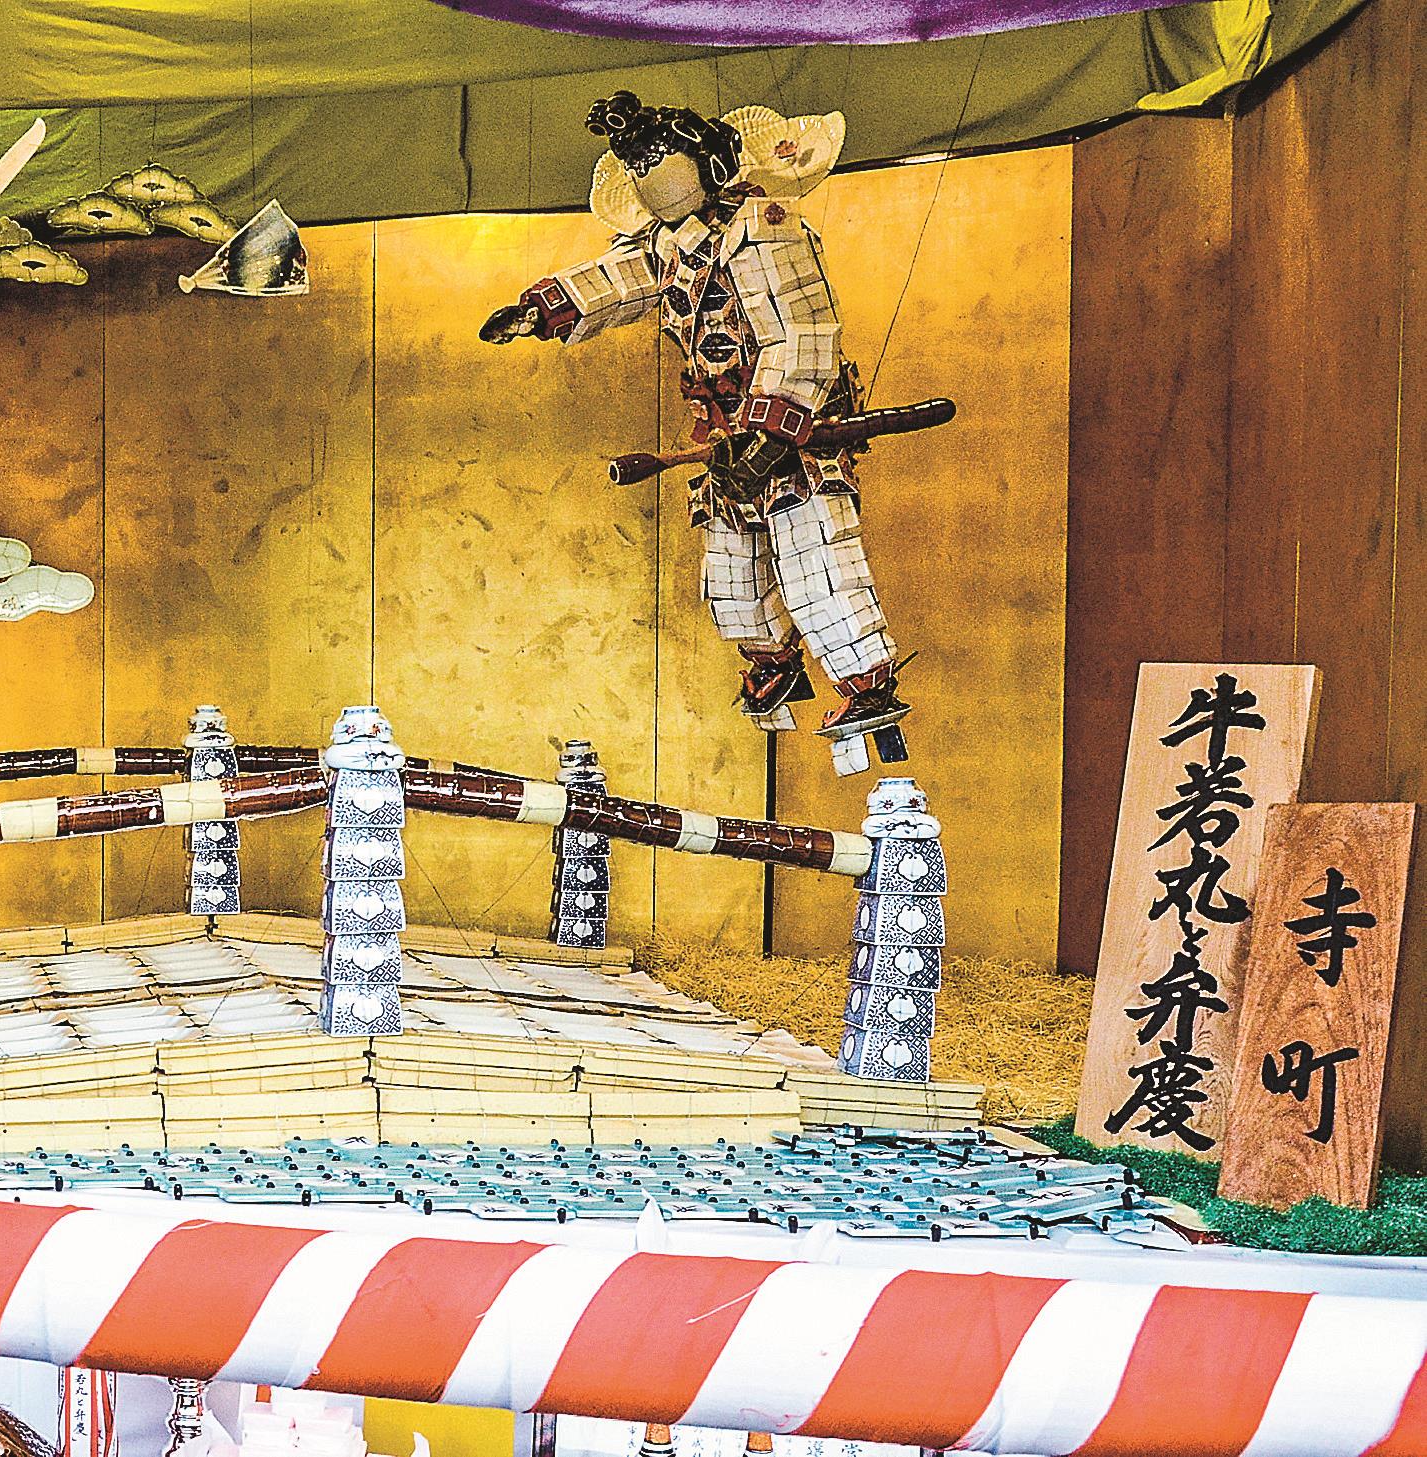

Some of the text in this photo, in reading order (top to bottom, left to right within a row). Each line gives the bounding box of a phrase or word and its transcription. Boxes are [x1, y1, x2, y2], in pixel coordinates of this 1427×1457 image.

[1104, 673, 1266, 1152] 牛若丸と弁慶
[1262, 868, 1377, 1144] 寺町
